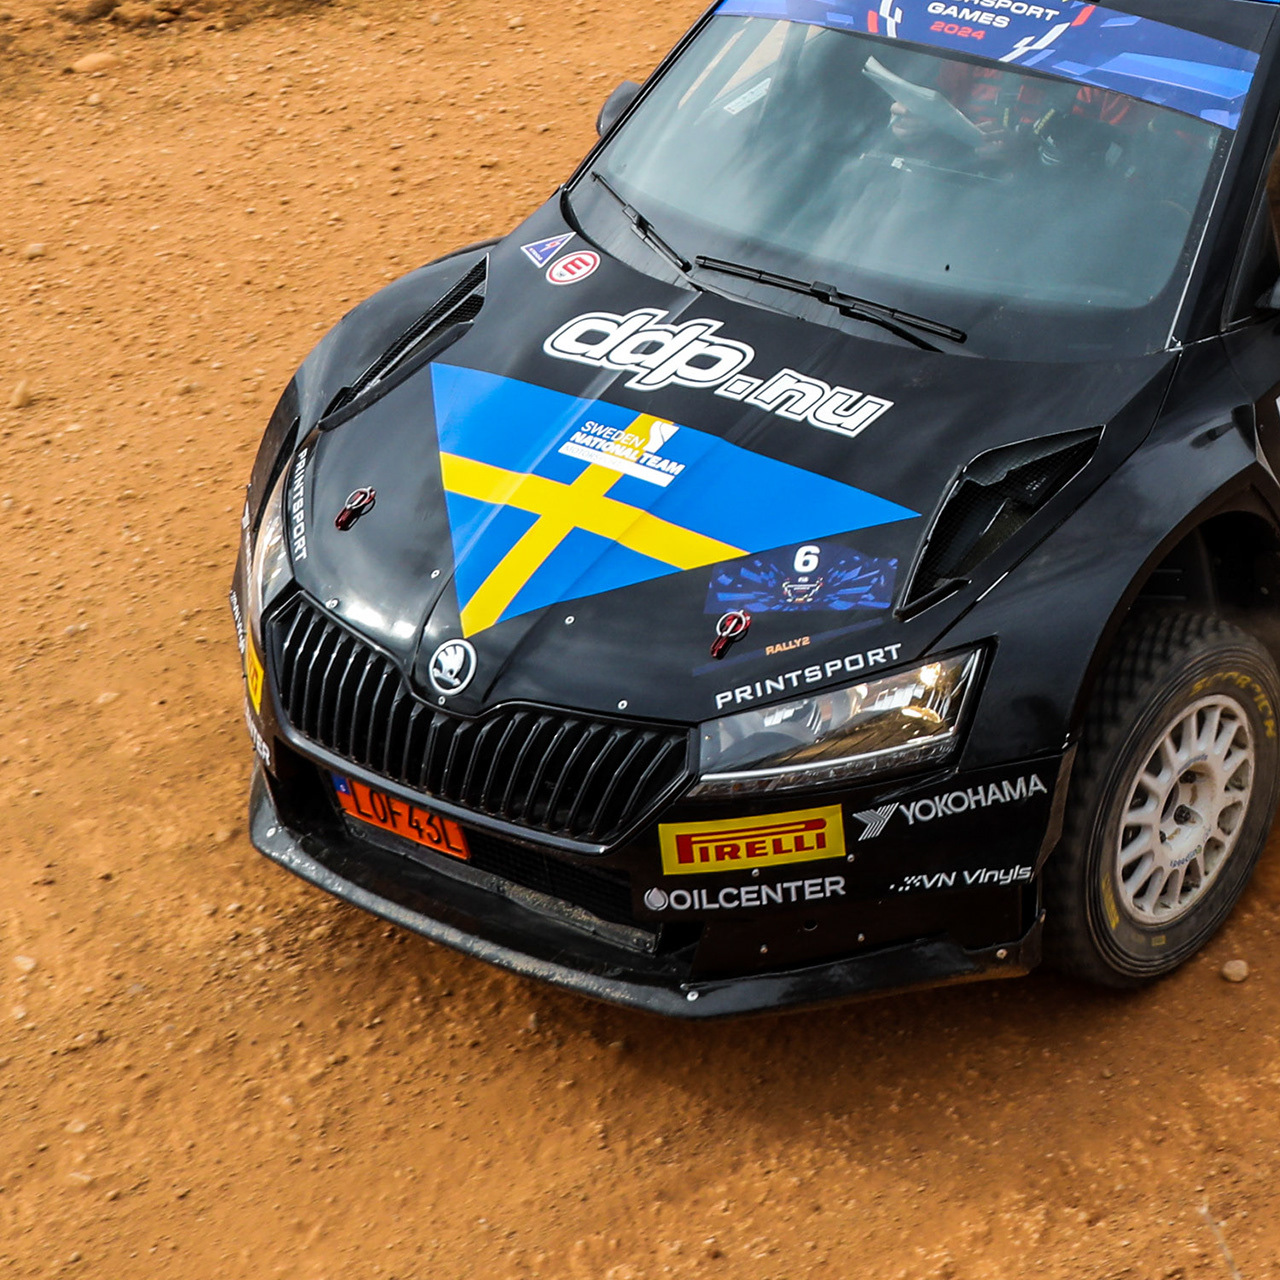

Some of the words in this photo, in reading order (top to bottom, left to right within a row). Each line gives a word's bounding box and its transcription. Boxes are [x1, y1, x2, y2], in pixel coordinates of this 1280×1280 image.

[927, 1, 1010, 29] GAMES
[929, 20, 986, 41] 2024
[542, 306, 895, 438] ddp.nu
[581, 420, 646, 449] SWEDEN
[569, 431, 641, 461] NATIONAL
[638, 451, 686, 476] TEAM
[292, 447, 308, 562] PRINTSPORT
[793, 544, 821, 573] 6
[765, 636, 811, 656] RALLY2
[714, 643, 902, 710] PRINTSPORT
[900, 772, 1048, 826] YOKOHAMA
[675, 817, 828, 865] PIRELLI
[668, 875, 847, 911] OILCENTER
[917, 871, 956, 891] VN
[962, 864, 1033, 886] Vinyls
